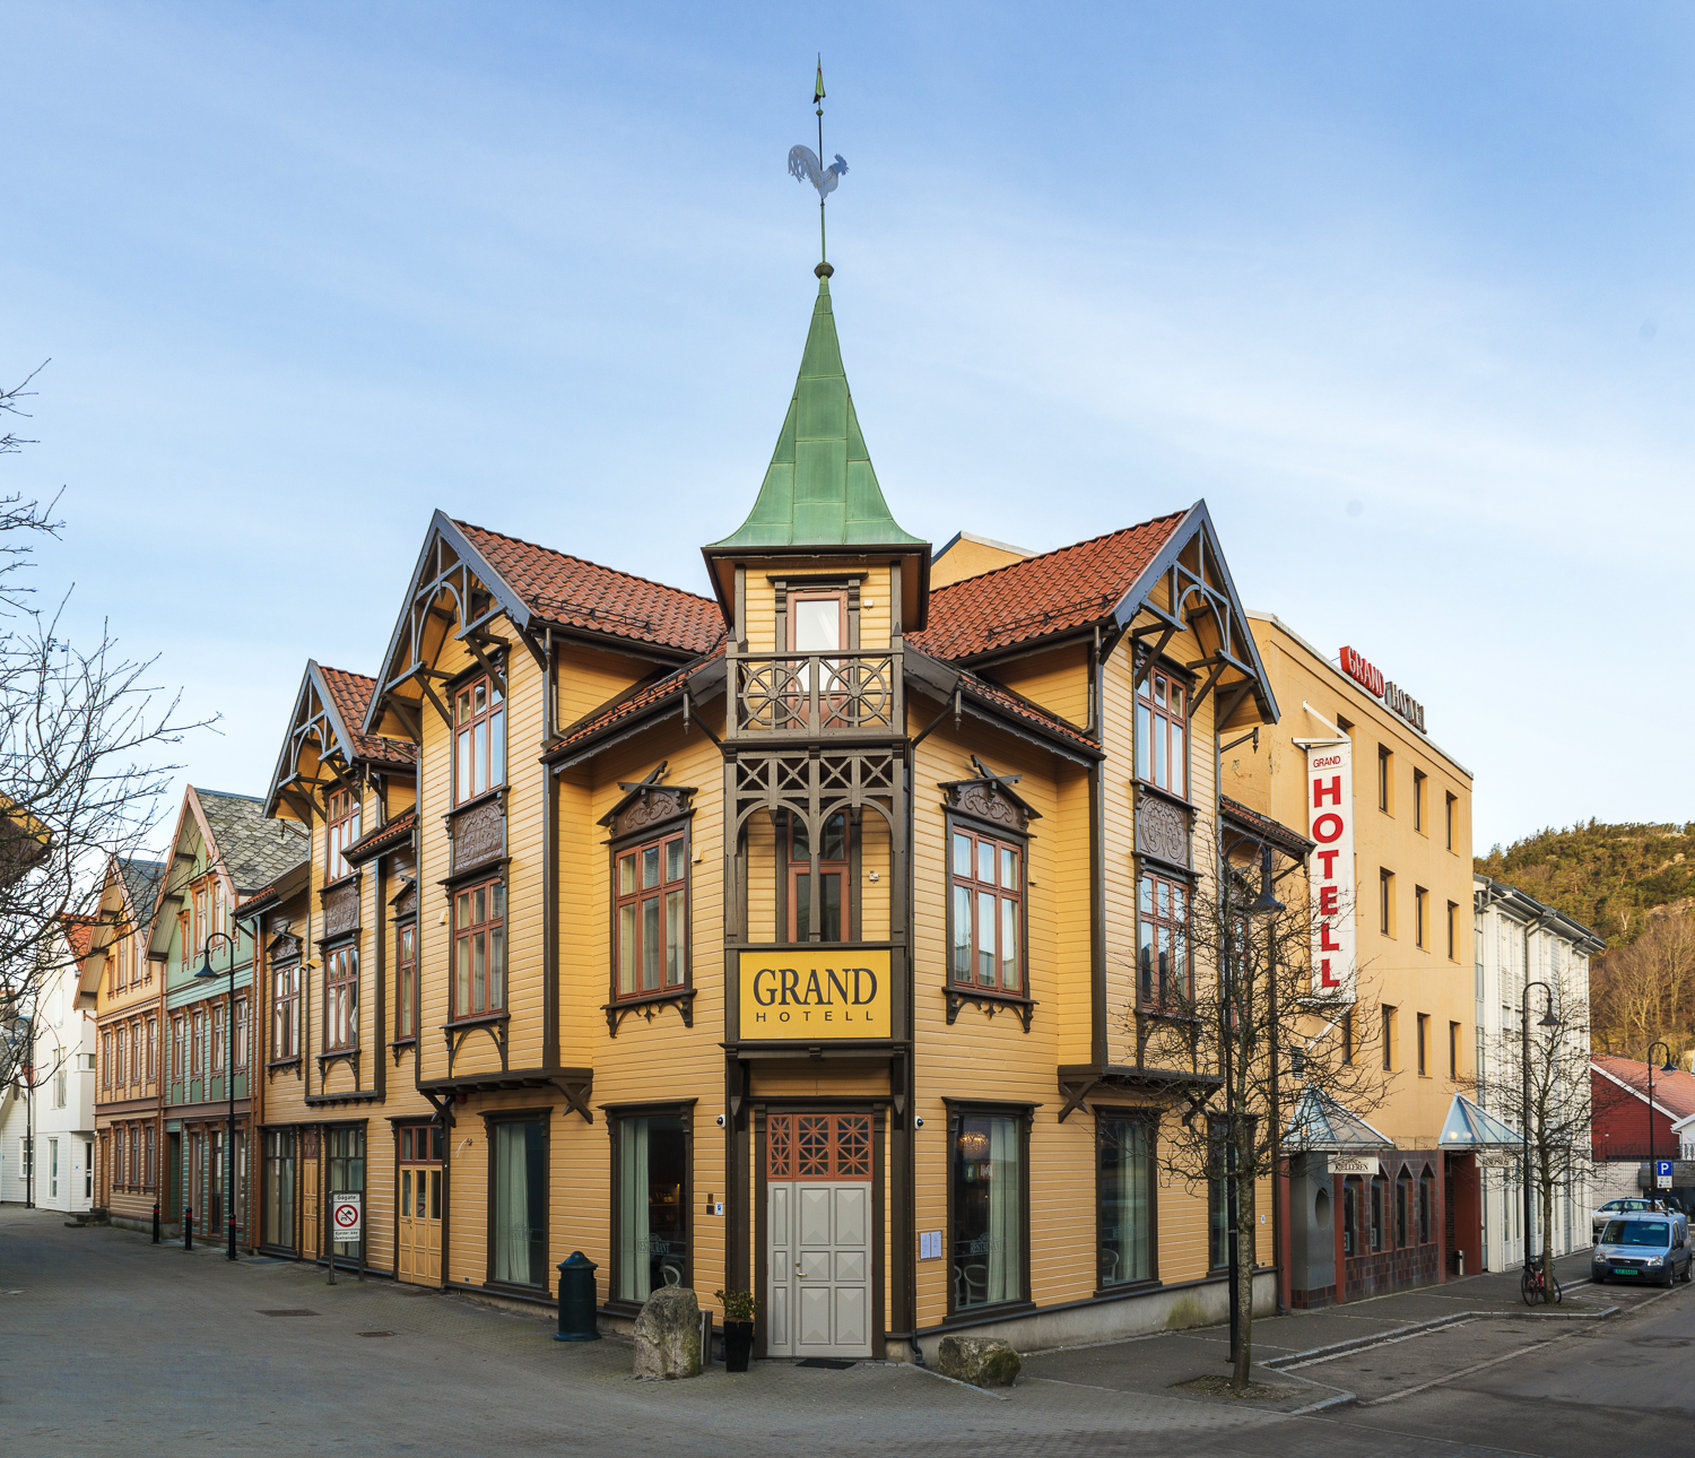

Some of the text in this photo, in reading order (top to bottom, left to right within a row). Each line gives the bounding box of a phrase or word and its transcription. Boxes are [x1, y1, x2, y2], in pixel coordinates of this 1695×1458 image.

[1340, 646, 1384, 698] GRAND
[1313, 755, 1341, 768] GRAND
[1312, 775, 1344, 988] HOTELL
[753, 968, 878, 1007] GRAND
[756, 1010, 873, 1022] HOTELL
[1661, 1163, 1669, 1174] P
